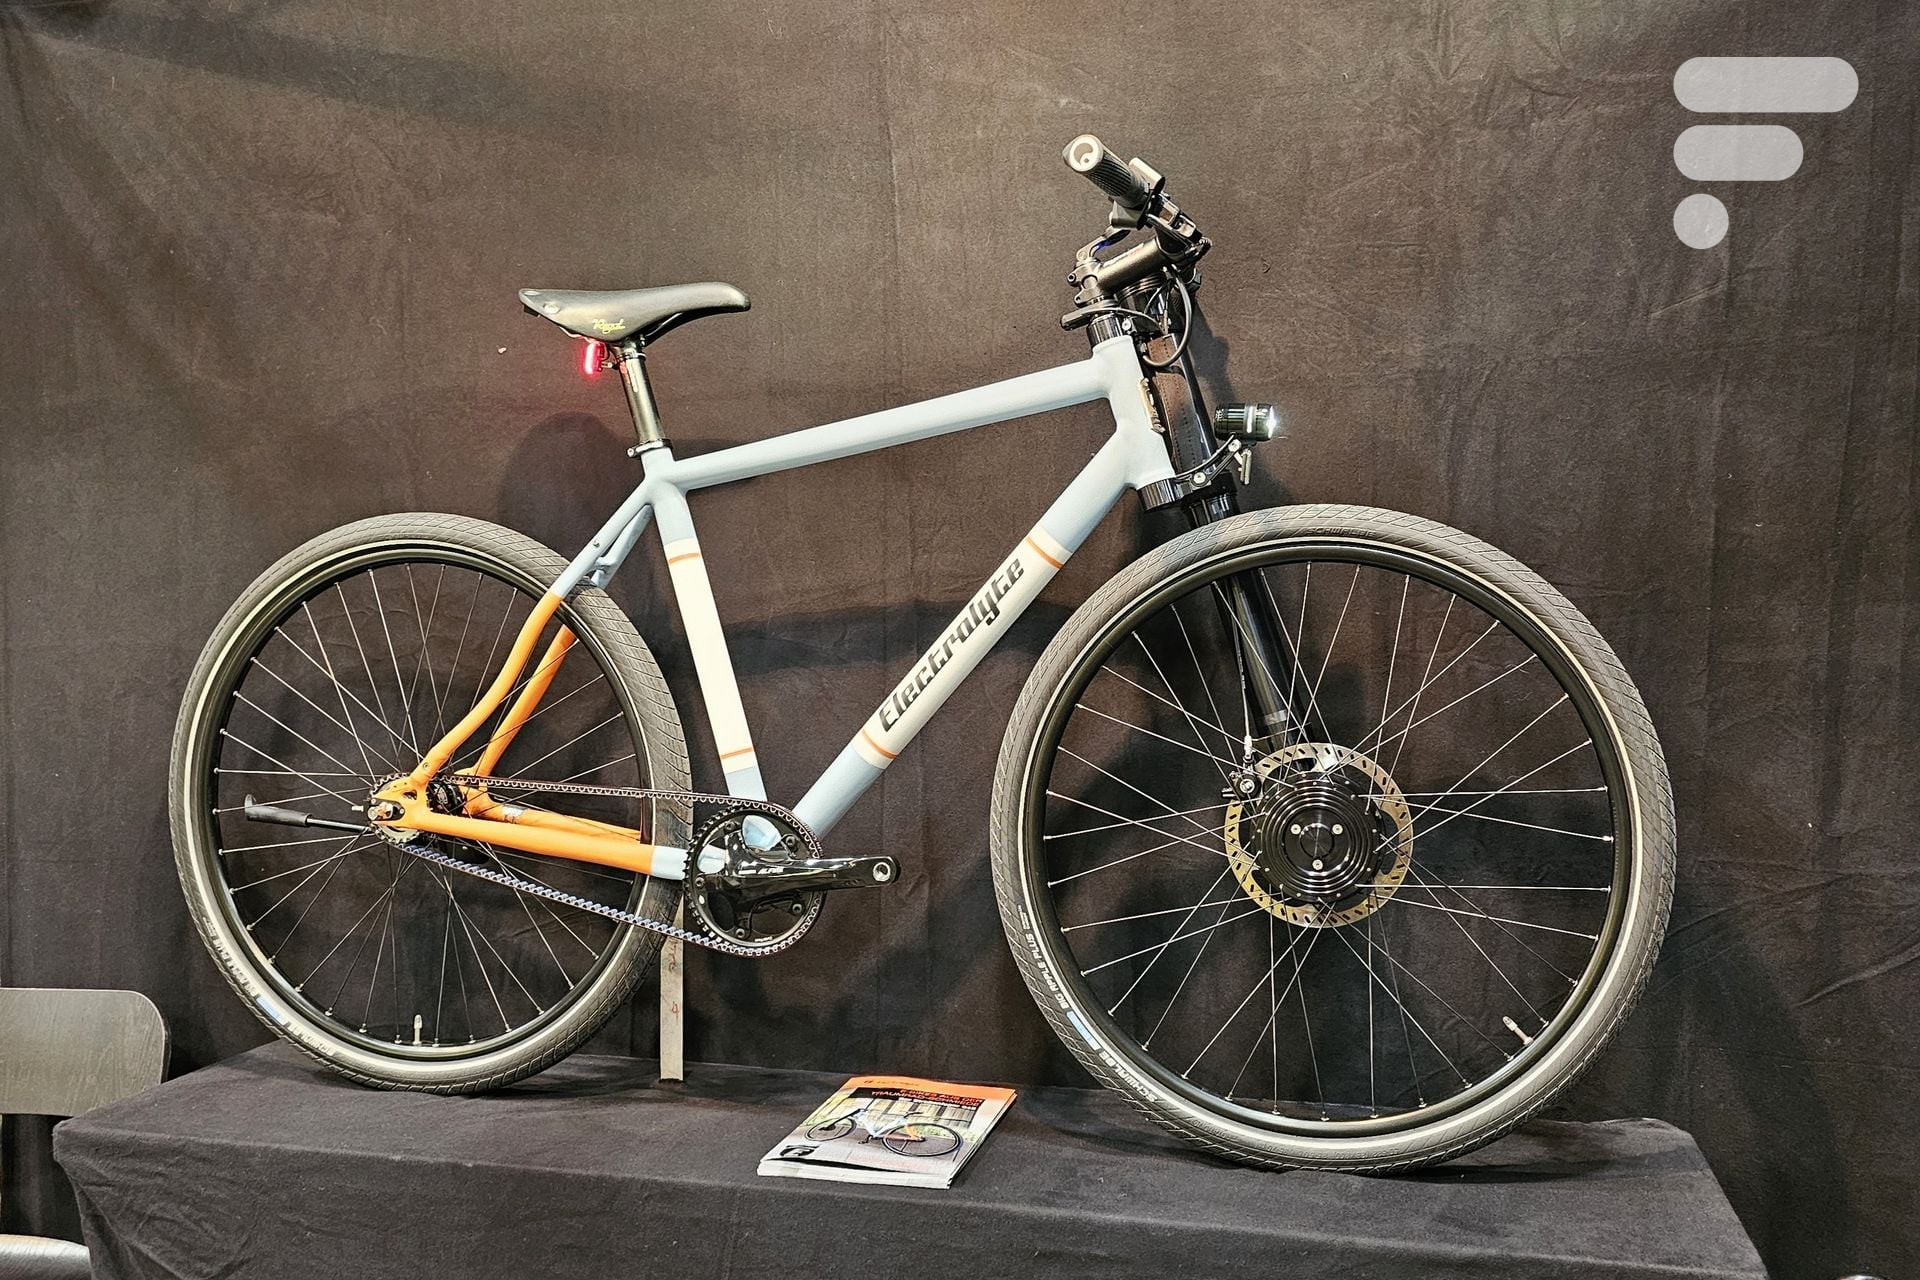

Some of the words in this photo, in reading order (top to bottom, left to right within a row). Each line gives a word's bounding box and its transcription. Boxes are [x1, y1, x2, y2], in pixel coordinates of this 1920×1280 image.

[592, 318, 626, 335] Regal
[878, 557, 1025, 732] Electrolyte
[1025, 933, 1041, 959] PLUS
[1038, 961, 1059, 992] APPLE
[1055, 993, 1069, 1009] BIG
[1098, 1050, 1158, 1103] SCHWALBE
